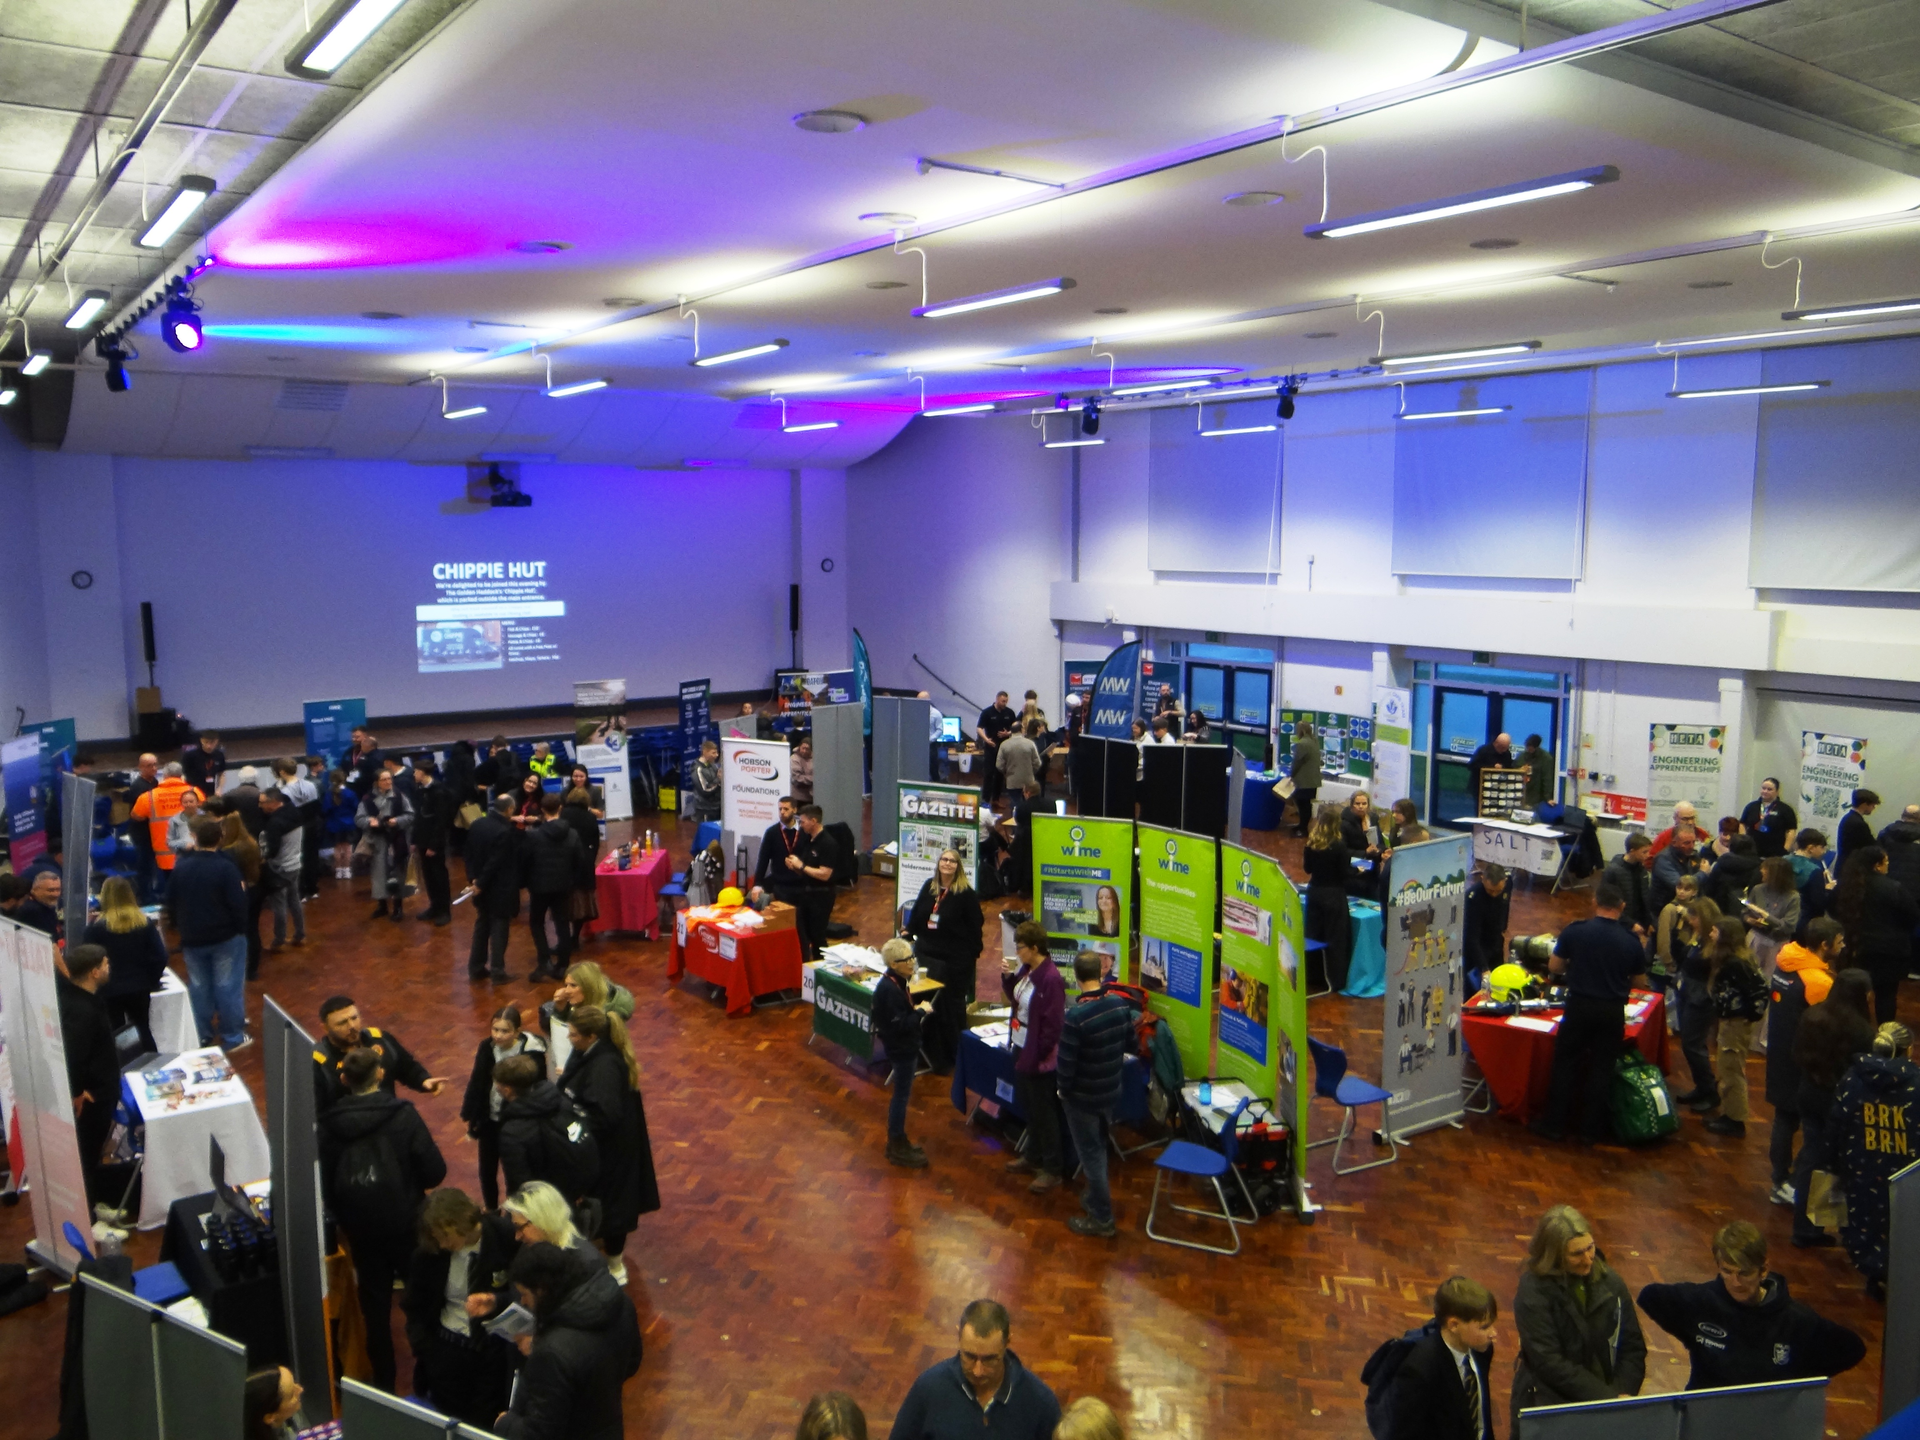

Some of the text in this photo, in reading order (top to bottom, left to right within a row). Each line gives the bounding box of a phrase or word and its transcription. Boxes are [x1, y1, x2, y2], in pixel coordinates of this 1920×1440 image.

[433, 561, 546, 580] CHIPPIE HUT
[452, 582, 476, 590] delighted
[1100, 677, 1131, 693] MW
[1094, 709, 1127, 725] MW
[1670, 732, 1704, 745] HETA
[1817, 742, 1848, 758] HETA
[739, 758, 771, 766] HOBSON
[1650, 765, 1720, 773] APPRENTICESHIPS
[1652, 756, 1718, 766] ENGINEERING
[741, 766, 772, 774] PORTER
[1802, 766, 1859, 782] ENGINEERING
[1802, 774, 1858, 789] APPRENTICESHIP
[732, 784, 780, 796] FOUNDATIONS
[902, 794, 974, 819] GAZETTE
[1483, 830, 1531, 852] SALT
[1156, 882, 1196, 898] opportunities
[1396, 881, 1464, 907] #BeOurFuture
[804, 976, 813, 989] 20
[816, 985, 869, 1033] GAZETTE
[1864, 1102, 1906, 1130] BRK
[1865, 1127, 1907, 1155] BRN
